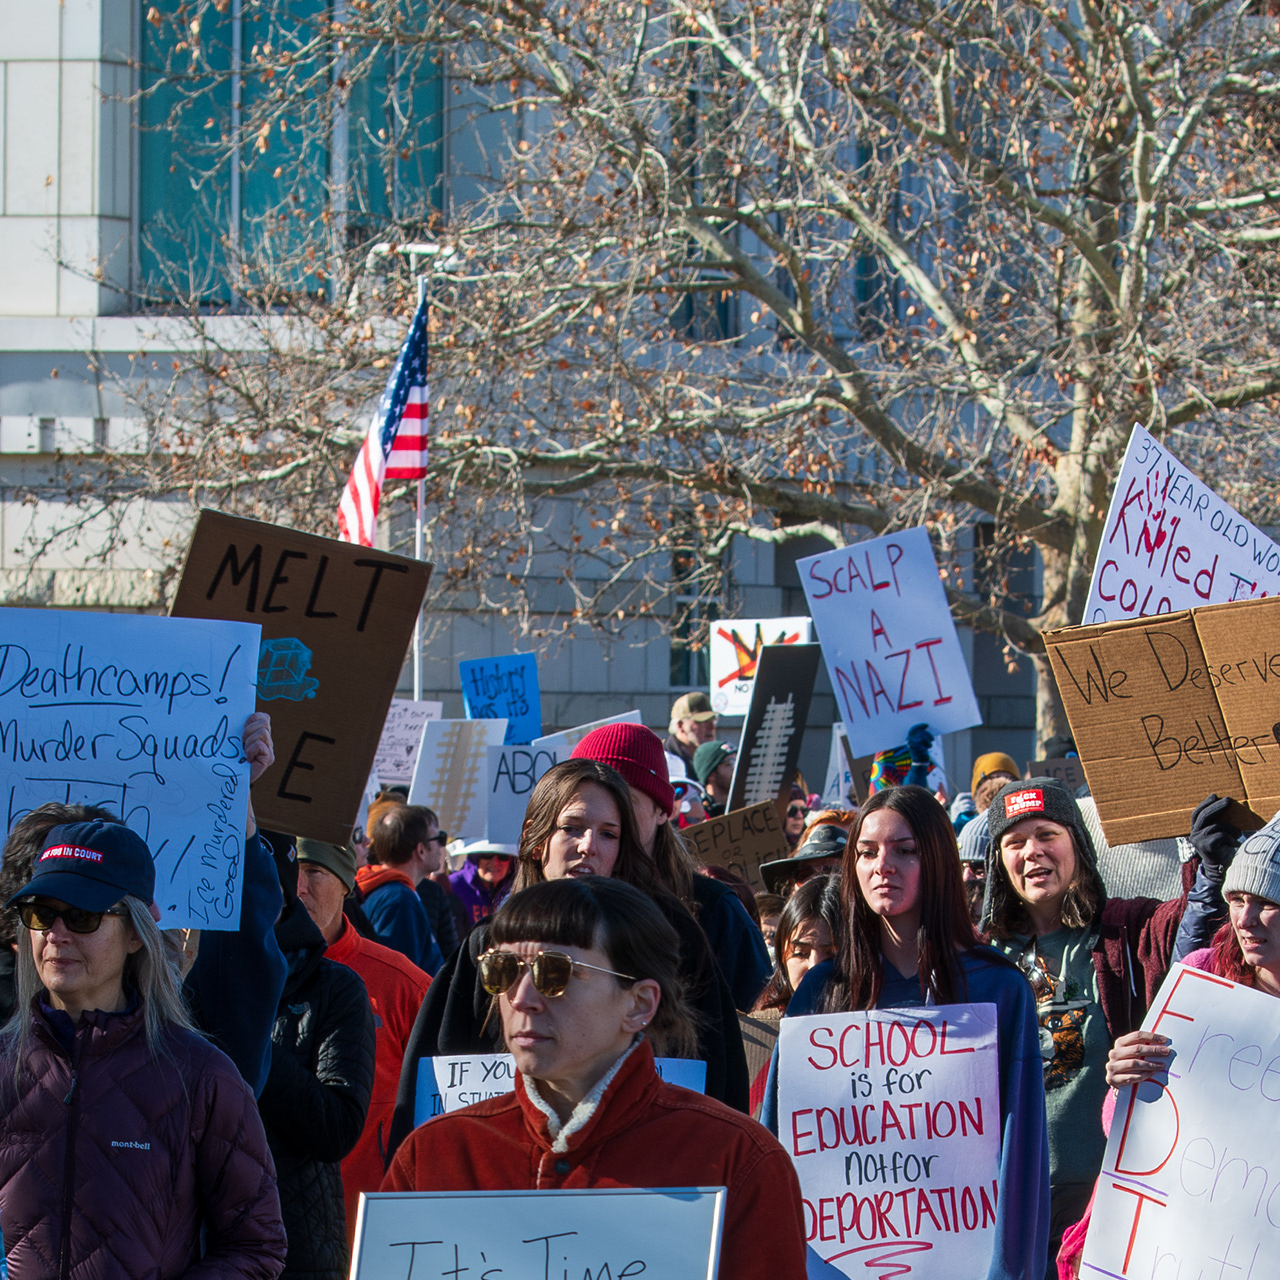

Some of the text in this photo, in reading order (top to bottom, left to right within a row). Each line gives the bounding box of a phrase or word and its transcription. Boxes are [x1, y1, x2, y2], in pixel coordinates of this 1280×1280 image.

[1135, 438, 1162, 475] 37
[1161, 461, 1210, 521] YEAR
[1210, 511, 1249, 547] OLD
[207, 544, 409, 632] MELT
[870, 609, 893, 652] A
[470, 663, 526, 699] History
[835, 638, 953, 725] NAZI
[1058, 644, 1131, 707] We
[1141, 714, 1270, 771] Better
[1045, 767, 1074, 784] ICE
[1007, 800, 1042, 812] TRUMP
[692, 808, 780, 854] EPLACE
[63, 846, 73, 856] IN
[74, 847, 102, 862] COURT
[808, 1020, 975, 1070] SCHOOL
[447, 1061, 472, 1088] IF
[851, 1067, 932, 1098] is for
[430, 1093, 447, 1116] IN
[792, 1097, 984, 1157] EDUCATION
